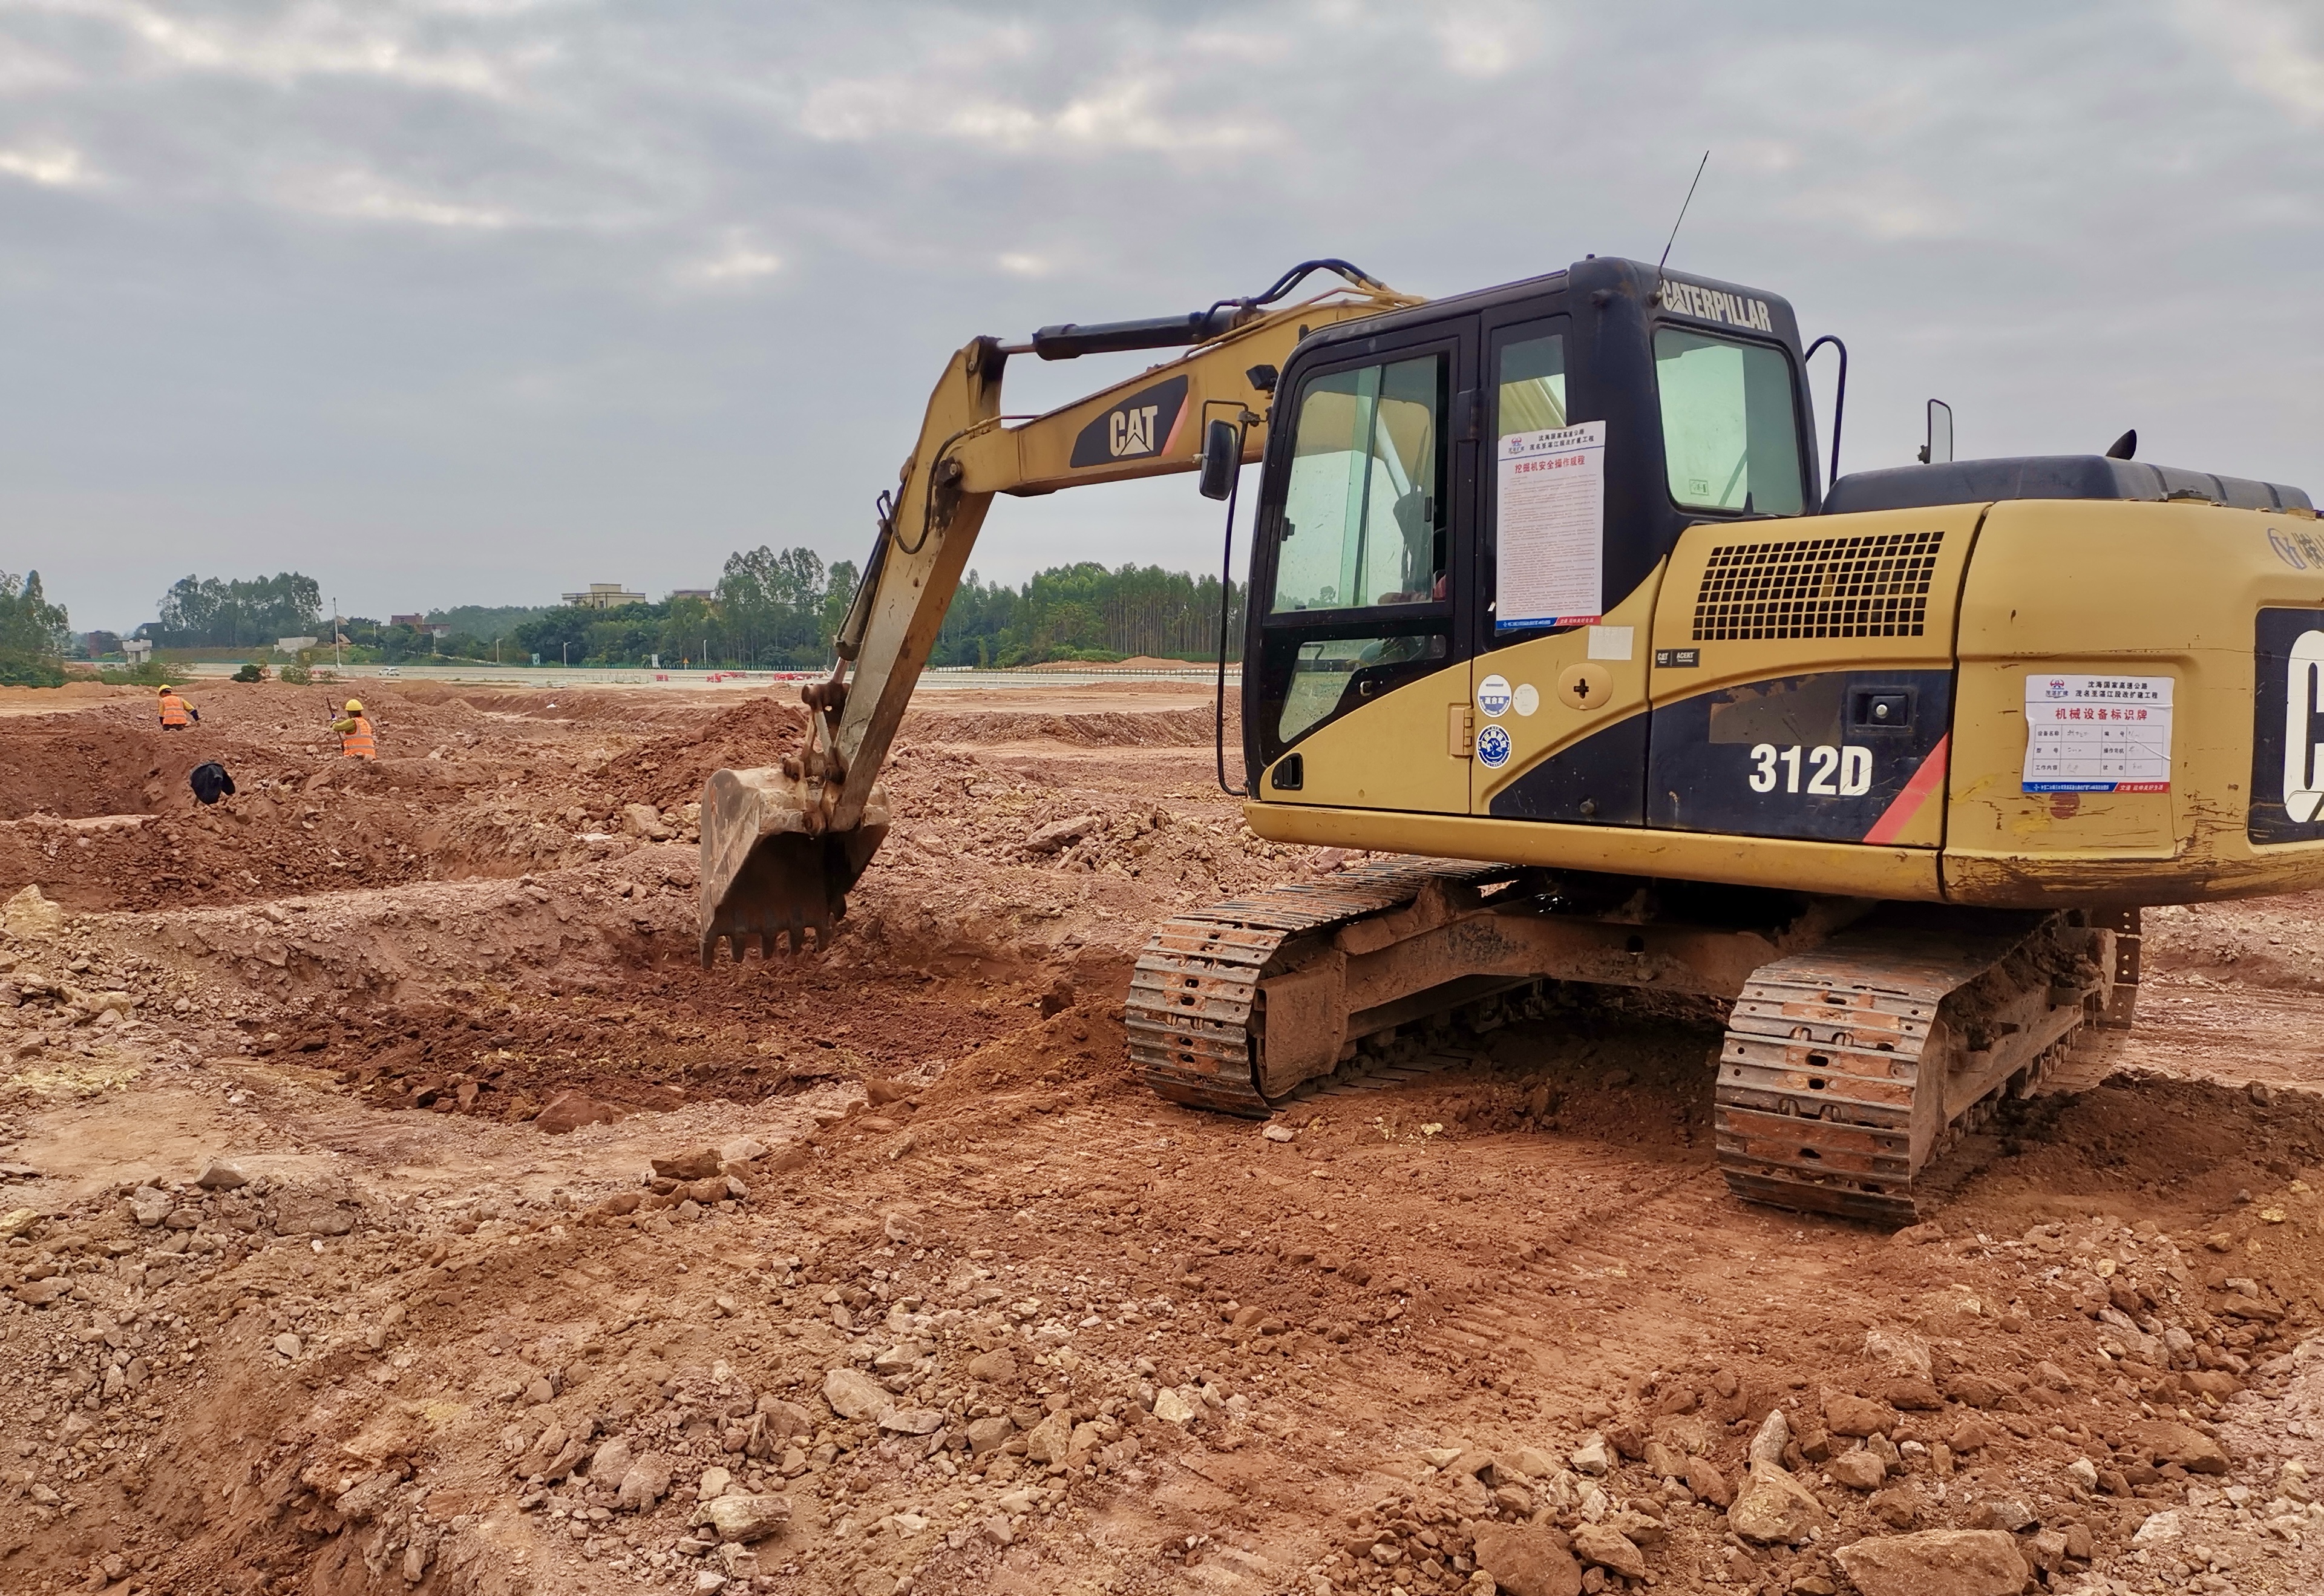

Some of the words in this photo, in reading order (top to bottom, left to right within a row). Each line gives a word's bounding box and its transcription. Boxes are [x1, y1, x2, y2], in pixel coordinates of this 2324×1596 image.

[1659, 279, 1772, 332] CATERPILLAR
[1110, 405, 1158, 457] CAT
[1514, 455, 1585, 474] 挖掘机安全操作规程
[1657, 652, 1669, 661] CAT
[2087, 681, 2147, 690] 沈海国家高速公路
[2075, 689, 2158, 699] 茂名至湛江段改扩建工程
[2055, 708, 2147, 721] 机械设备标识牌
[1749, 743, 1873, 796] 312D
